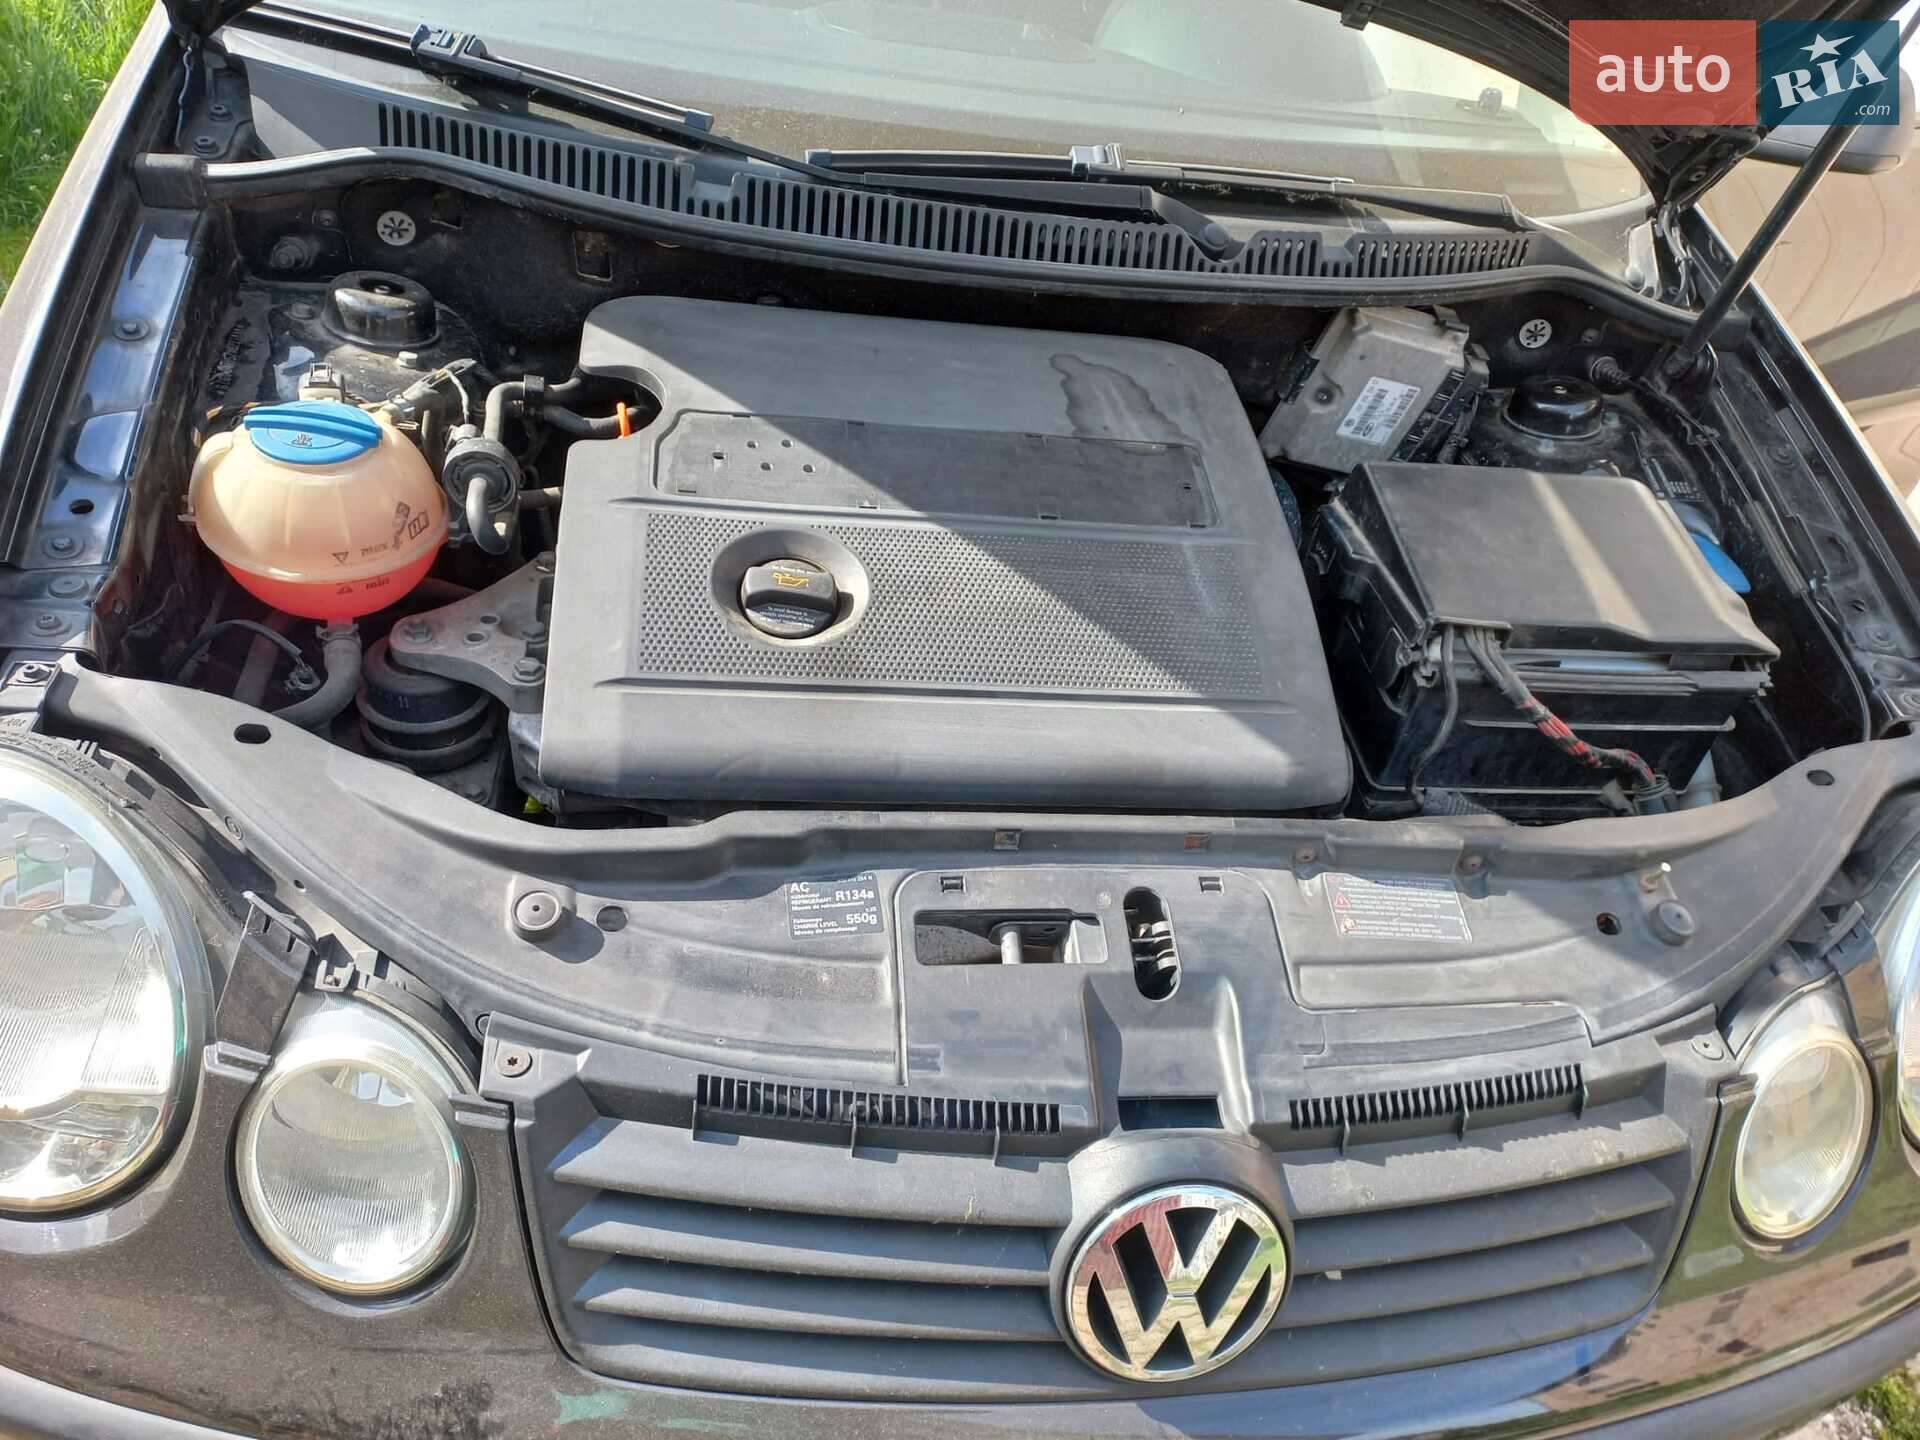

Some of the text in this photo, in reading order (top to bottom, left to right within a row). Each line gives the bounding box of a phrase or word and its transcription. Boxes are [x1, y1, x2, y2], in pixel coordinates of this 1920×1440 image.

[366, 576, 391, 590] min
[790, 882, 810, 893] AC
[835, 889, 875, 901] R134a
[846, 912, 878, 925] 550g
